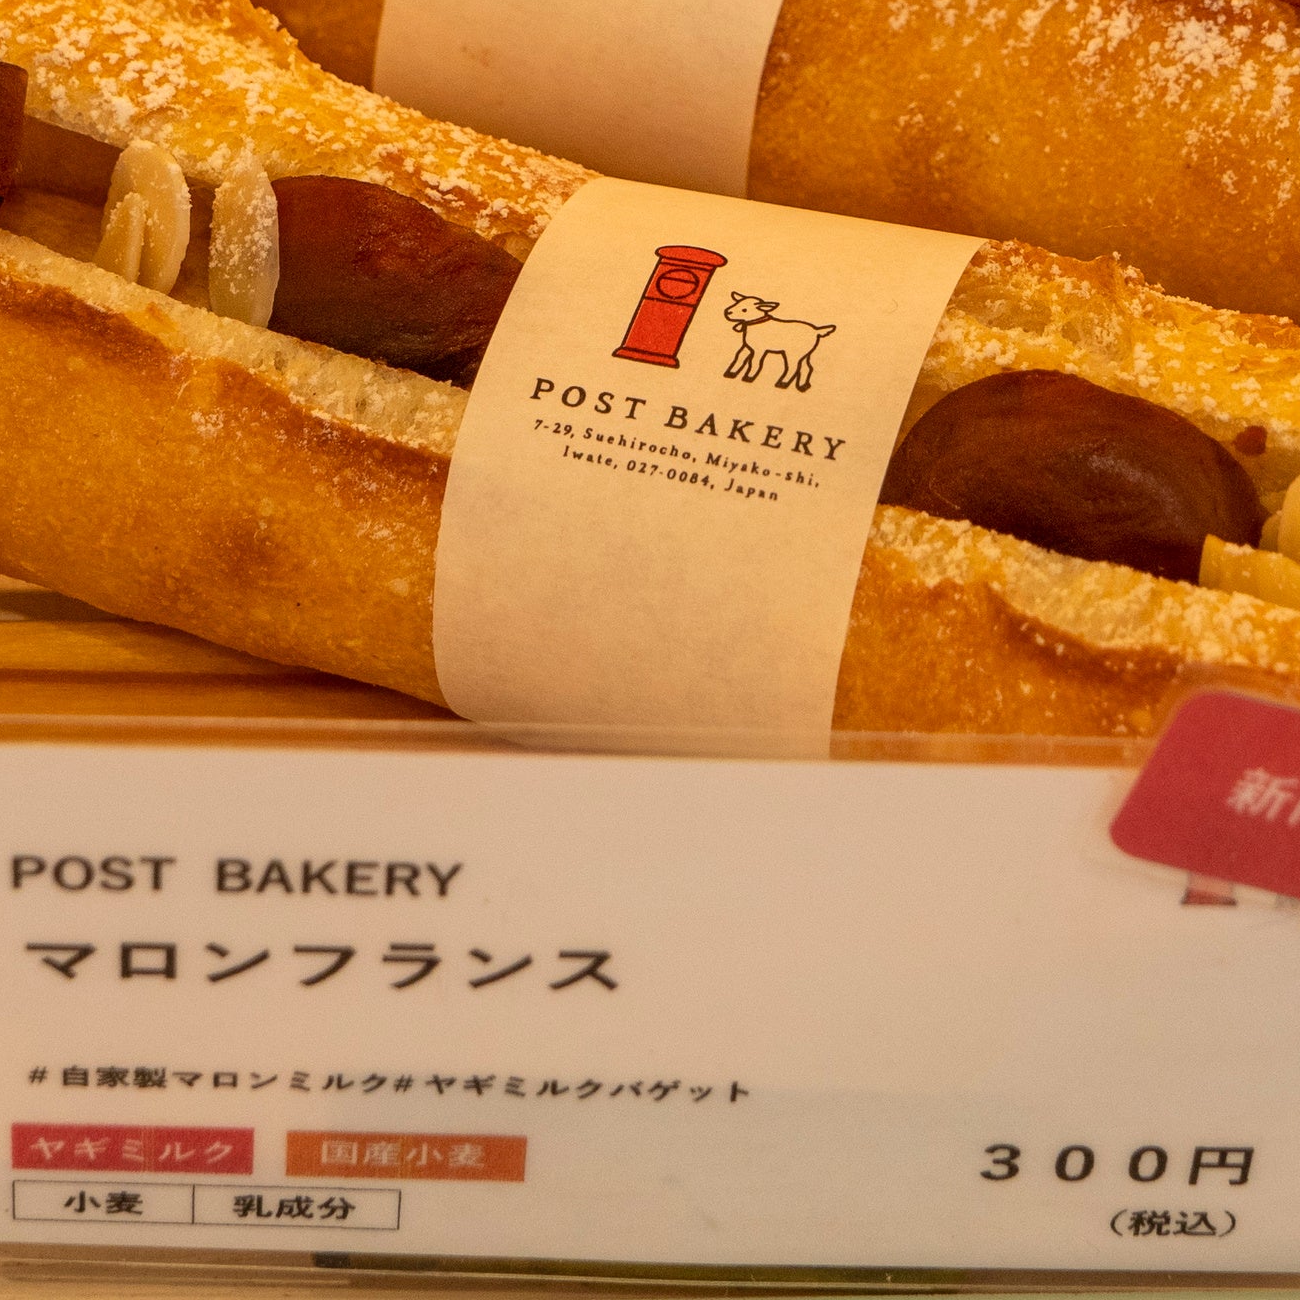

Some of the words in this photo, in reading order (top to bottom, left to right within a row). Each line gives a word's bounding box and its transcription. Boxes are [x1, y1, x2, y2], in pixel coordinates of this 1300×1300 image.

[530, 377, 646, 420] POST
[664, 406, 846, 461] BAKERY
[533, 419, 574, 439] 7-29,
[583, 427, 697, 463] Suehirocho,
[705, 452, 820, 488] Miyako-shi,
[563, 446, 618, 469] Iwate,
[627, 460, 714, 490] 027-0084,
[724, 479, 779, 501] Japan
[10, 854, 177, 892] POST
[215, 858, 465, 898] BAKERY
[25, 941, 619, 991] マロンフランス
[30, 1135, 234, 1165] ヤギミルク
[321, 1140, 485, 1169] 国産小麦
[64, 1192, 144, 1216] 小麦
[232, 1194, 356, 1221] 乳成分
[1109, 1210, 1237, 1238] (税込)
